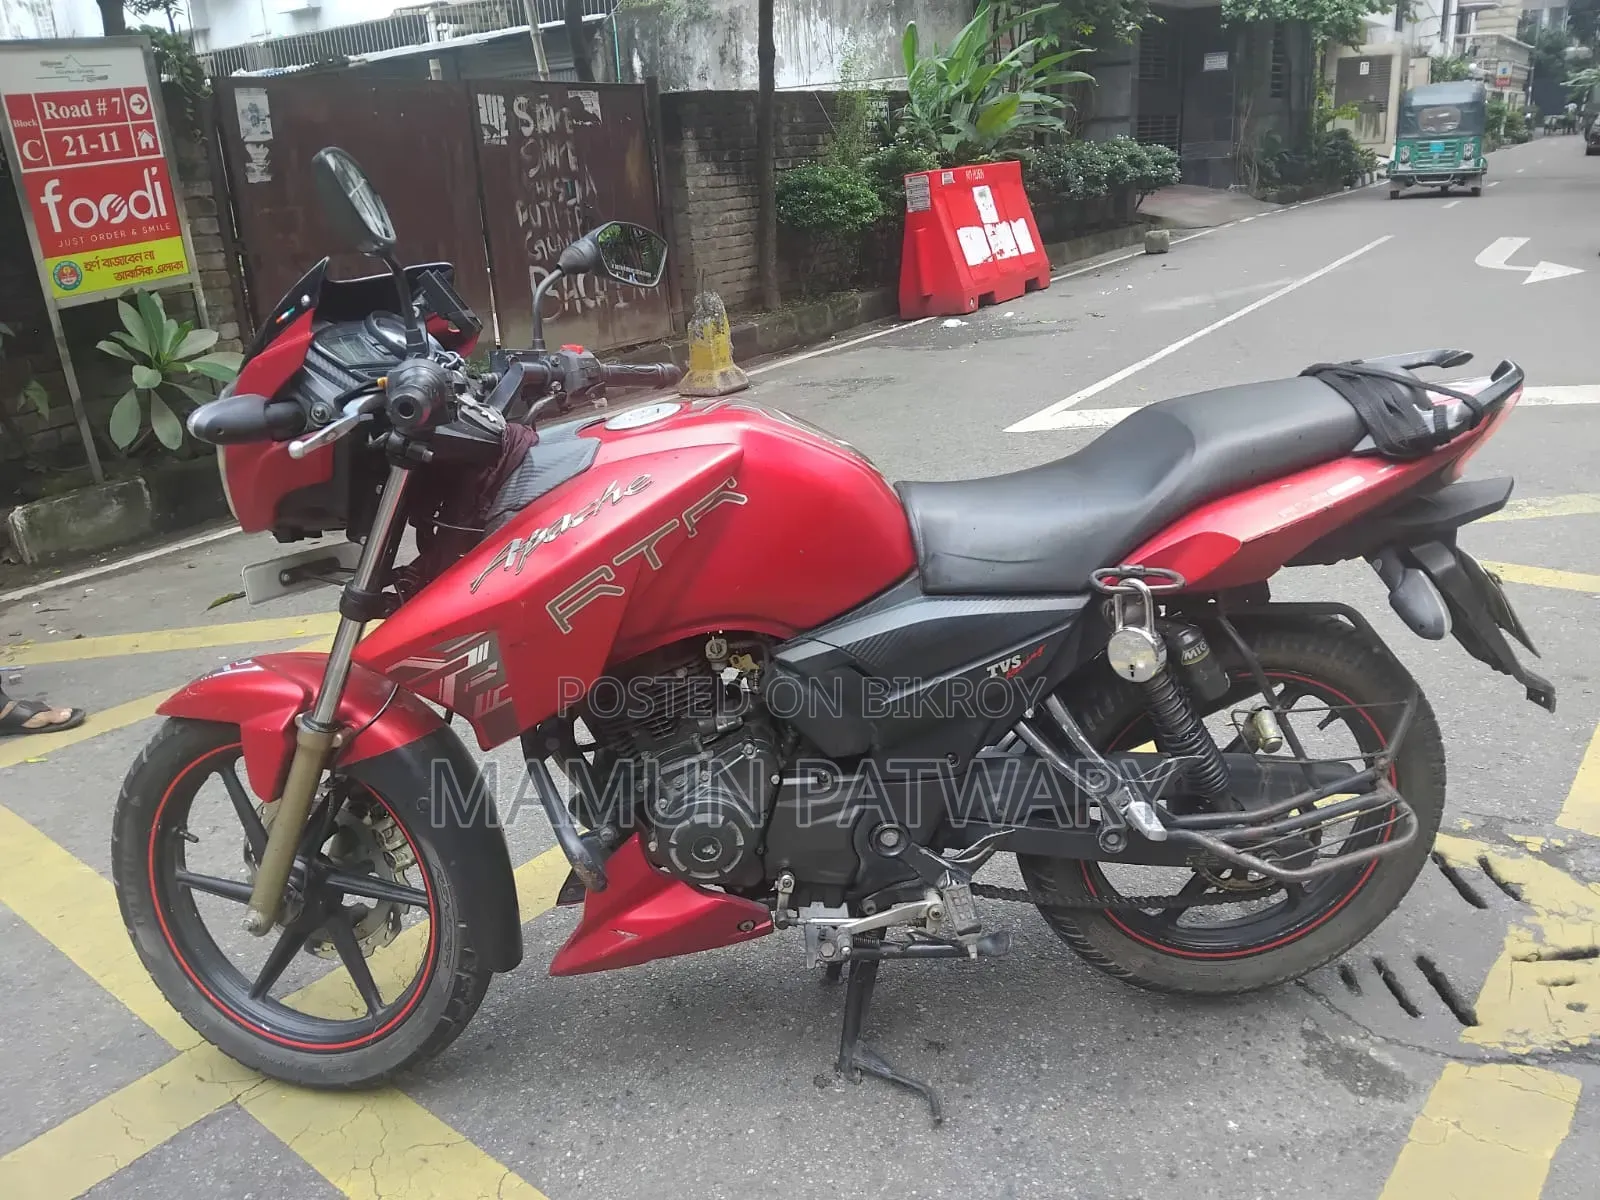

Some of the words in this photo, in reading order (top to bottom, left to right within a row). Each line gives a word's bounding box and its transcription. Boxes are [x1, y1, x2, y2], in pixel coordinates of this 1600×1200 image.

[42, 99, 93, 121] Road
[96, 98, 108, 117] #
[111, 97, 121, 115] 7
[13, 118, 39, 129] Block
[22, 139, 45, 162] C
[62, 131, 122, 158] 21-11
[40, 166, 168, 233] foodi
[58, 236, 85, 249] JUST
[90, 228, 127, 243] ORDER
[142, 221, 172, 235] SMILE
[101, 251, 144, 269] বাজাবেন
[144, 249, 156, 261] না
[113, 264, 155, 281] আবাসিক
[155, 260, 184, 274] এলাকা
[469, 473, 655, 595] Apache
[545, 476, 749, 635] RTR
[986, 653, 1022, 679] TVS
